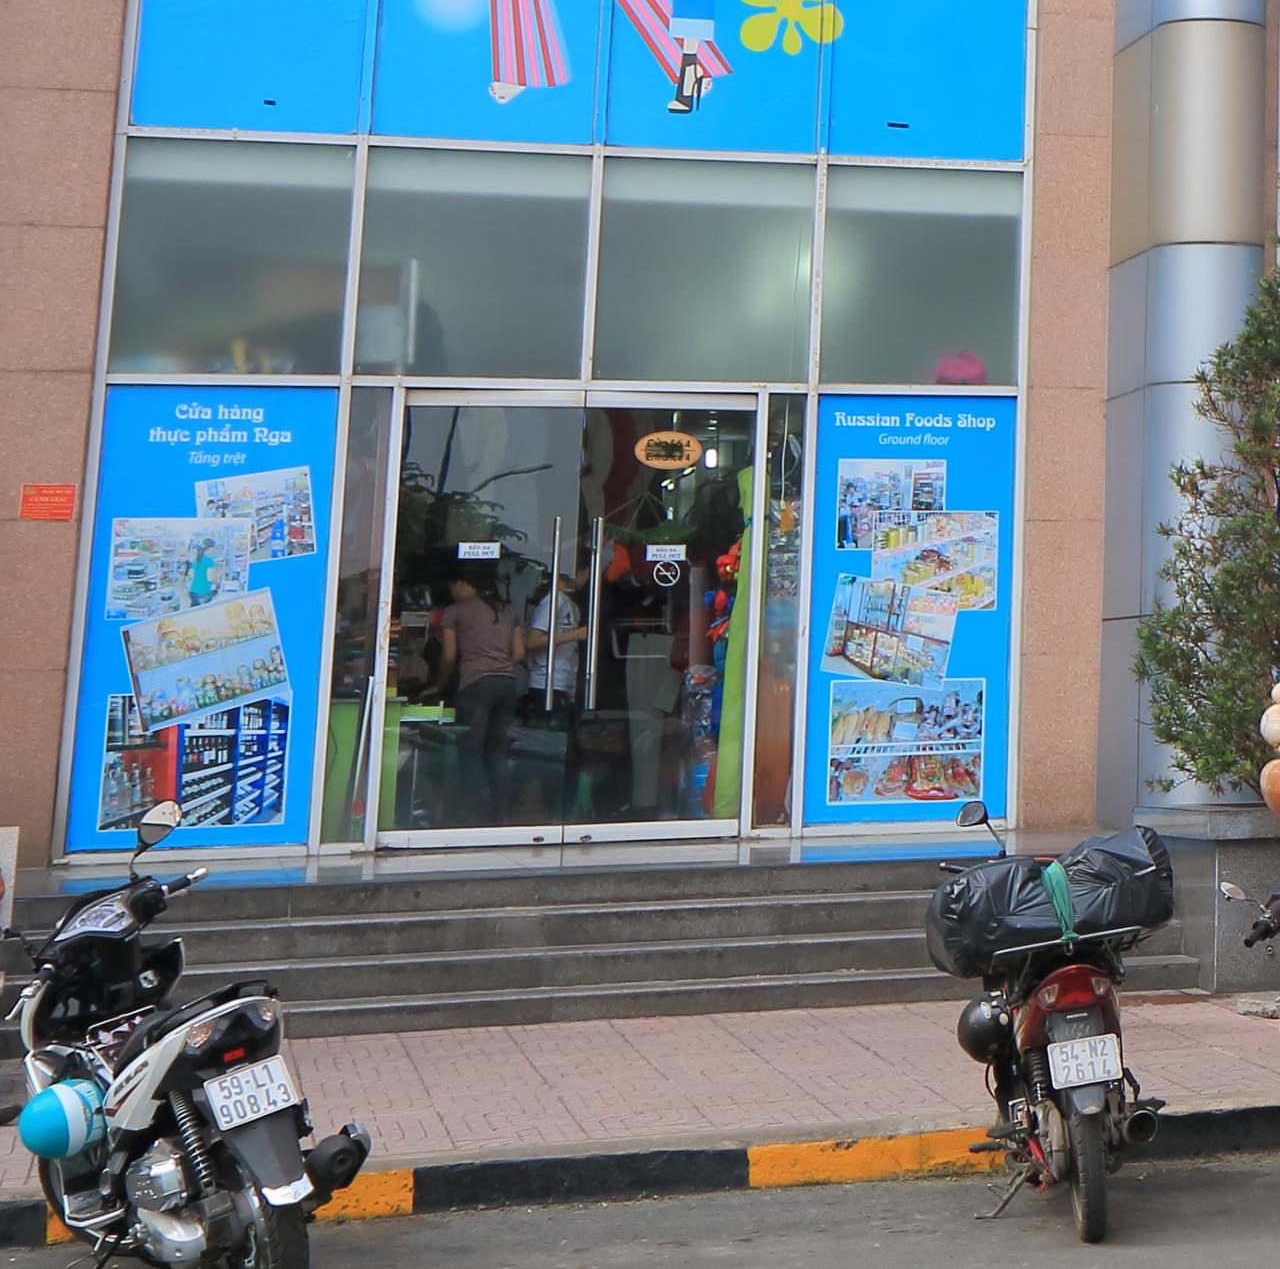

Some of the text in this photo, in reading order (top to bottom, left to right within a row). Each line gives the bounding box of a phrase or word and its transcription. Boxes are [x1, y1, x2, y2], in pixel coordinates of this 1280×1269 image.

[175, 402, 264, 423] Cửa hàng
[834, 412, 996, 431] Russian Foods Shop
[149, 427, 190, 446] thực
[195, 423, 248, 446] phẩm
[685, 439, 690, 448] 4
[878, 433, 950, 446] Ground floor
[223, 451, 246, 467] trệt
[685, 452, 690, 461] 4
[1060, 1040, 1109, 1063] 54-N2
[218, 1064, 275, 1100] 59-L1
[1063, 1059, 1112, 1084] 2614
[219, 1083, 292, 1125] 908.43
